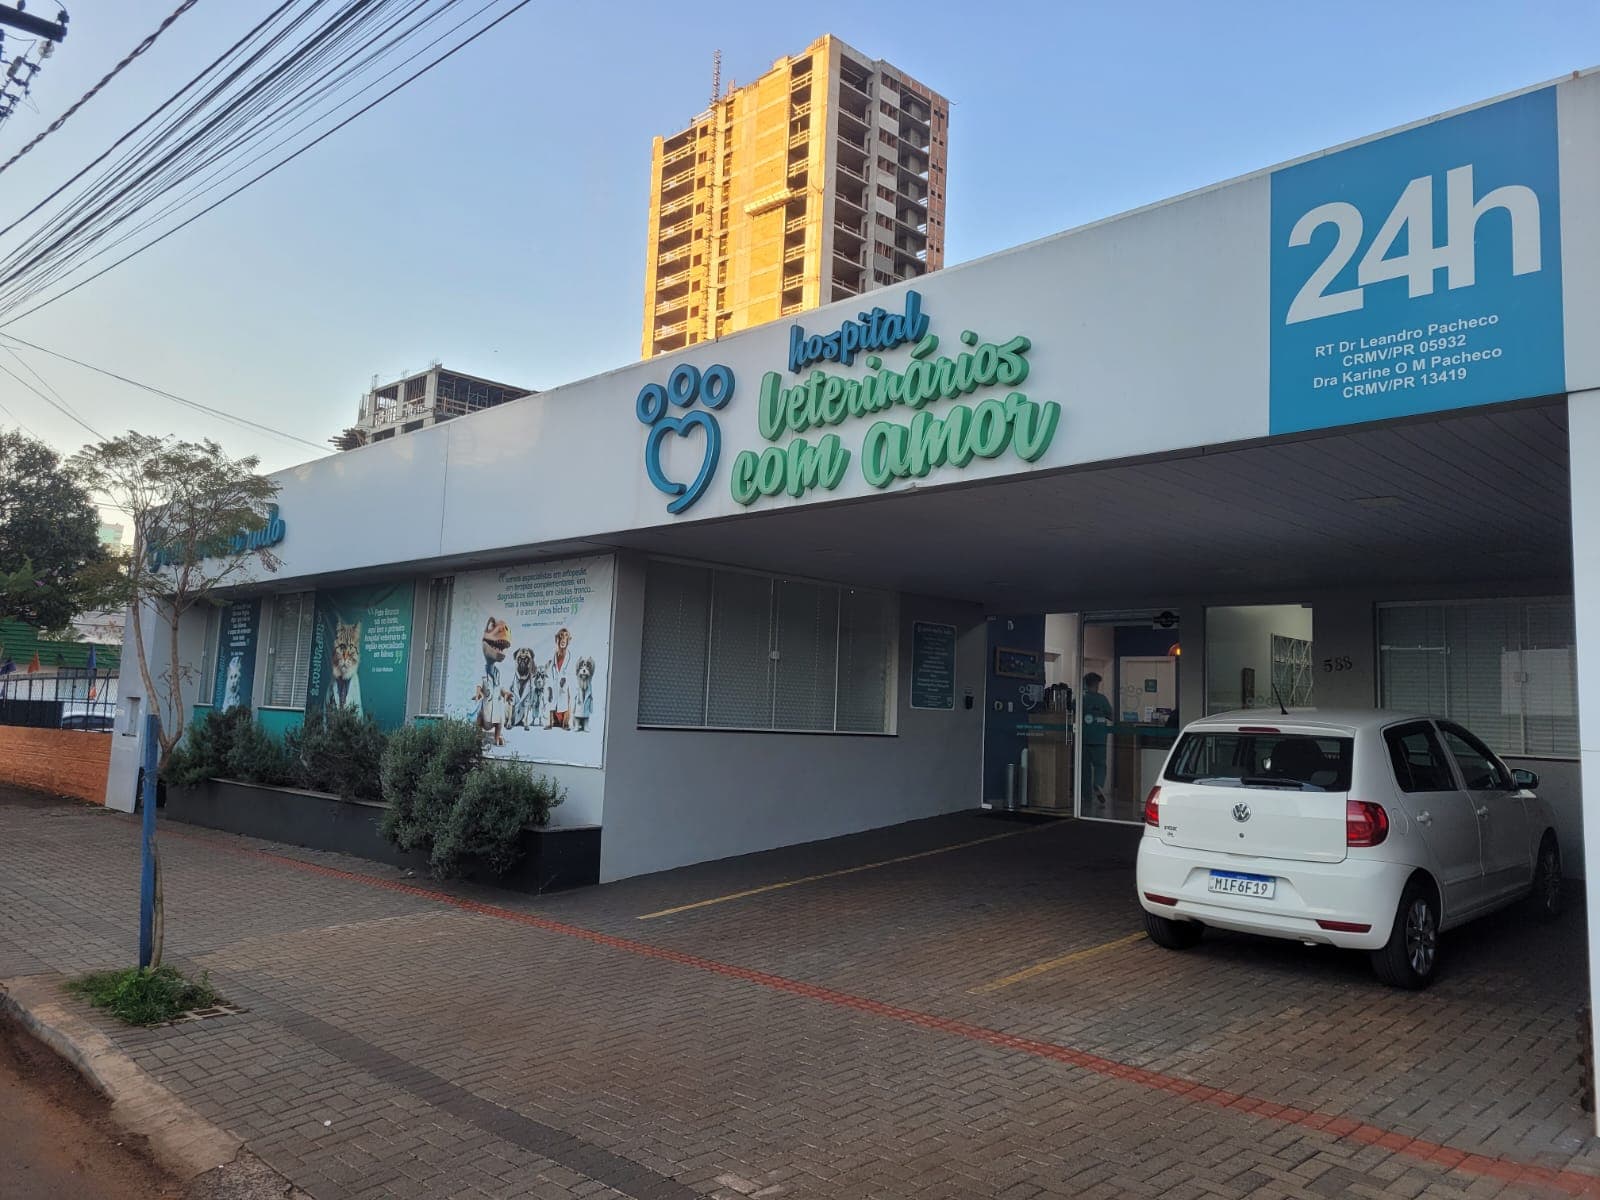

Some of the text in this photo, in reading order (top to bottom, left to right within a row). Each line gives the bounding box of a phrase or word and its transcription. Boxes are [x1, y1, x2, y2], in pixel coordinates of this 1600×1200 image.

[1285, 164, 1542, 325] 24h
[788, 290, 930, 373] hospital
[1315, 313, 1499, 358] RT Dr Leandro Pacheco
[1342, 334, 1467, 367] CRMV/PR 05932
[758, 329, 1032, 441] Veterinários
[1313, 347, 1503, 389] Dra Karine O M Pacheco
[1342, 367, 1467, 399] CRMV/PR 13419
[730, 391, 1062, 506] com amor
[1215, 878, 1269, 895] MIF6F19
